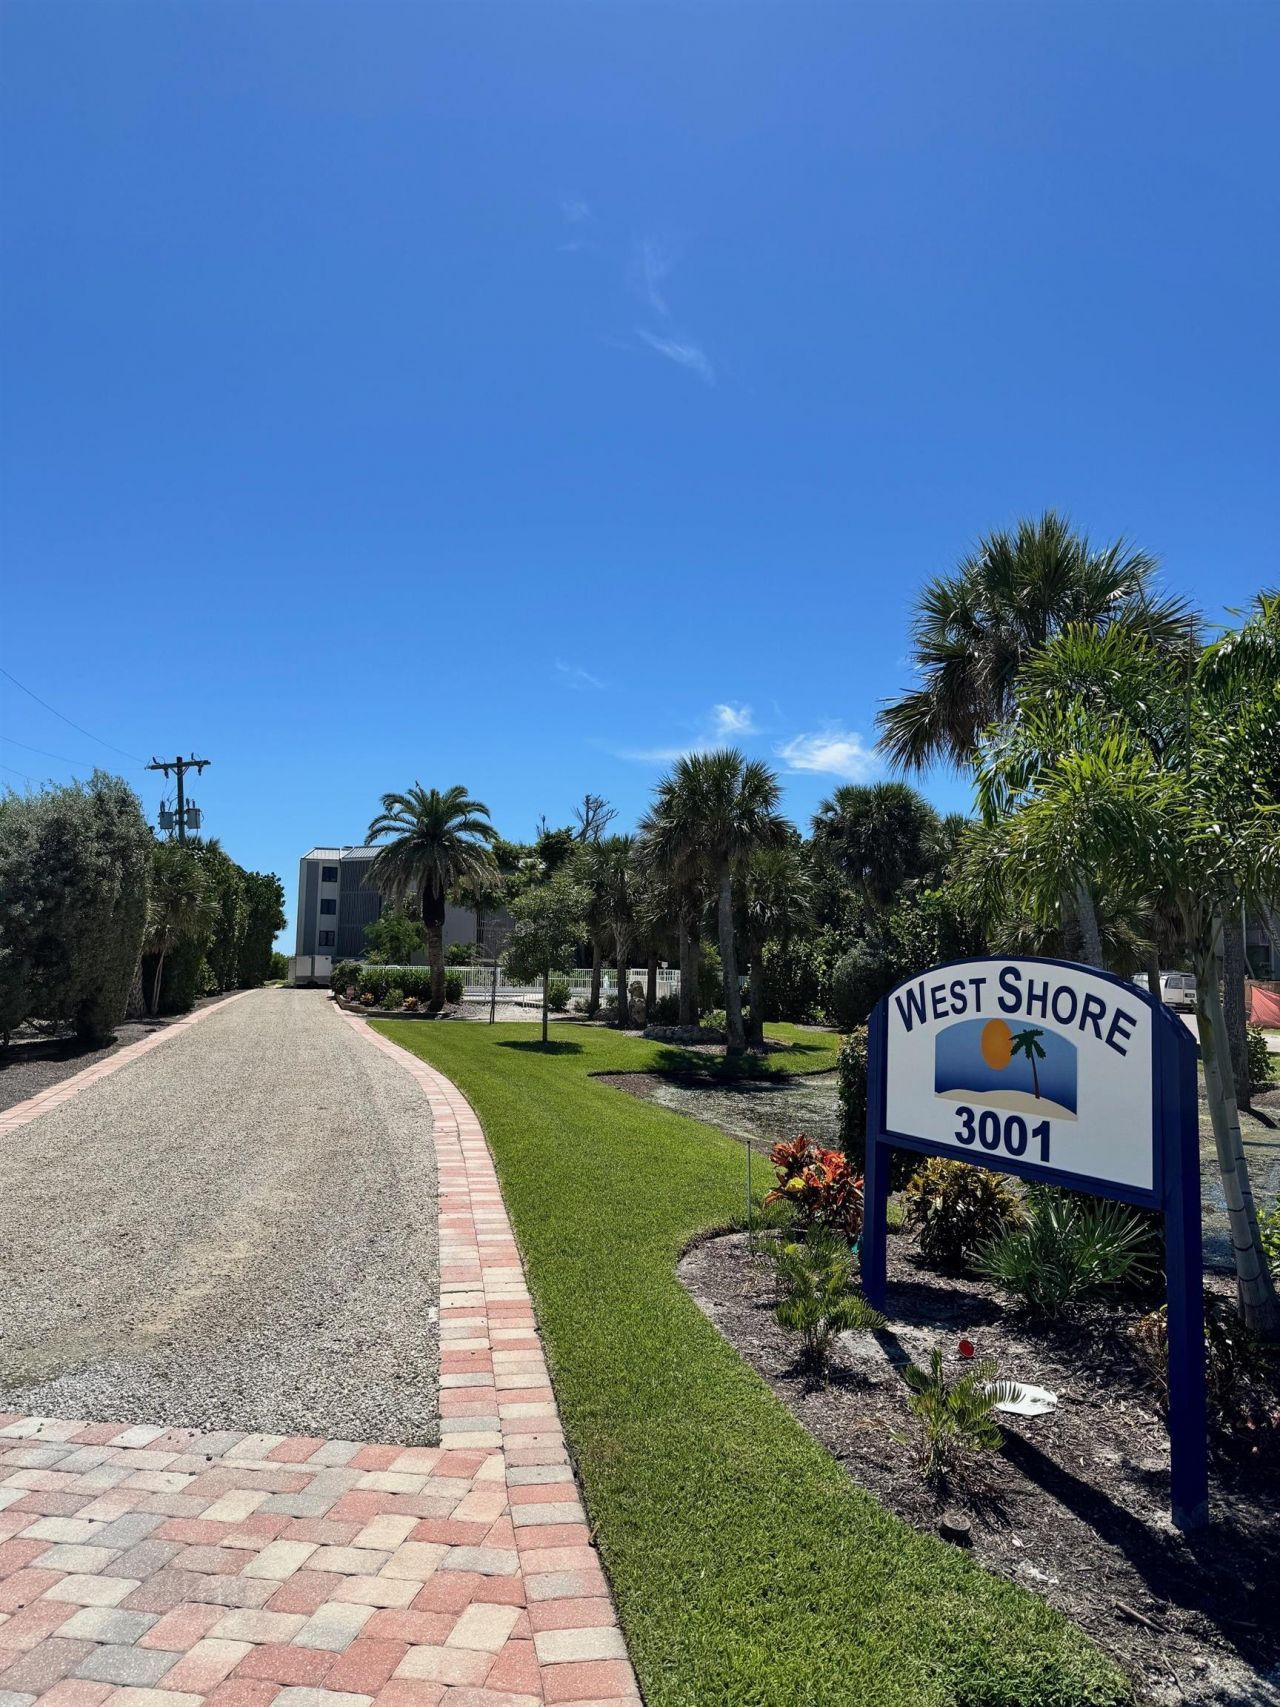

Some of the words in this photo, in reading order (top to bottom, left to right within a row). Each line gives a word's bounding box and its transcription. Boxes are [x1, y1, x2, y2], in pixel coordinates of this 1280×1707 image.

[896, 978, 987, 1032] WEST
[997, 966, 1137, 1056] SHORE
[954, 1106, 1051, 1162] 3001
